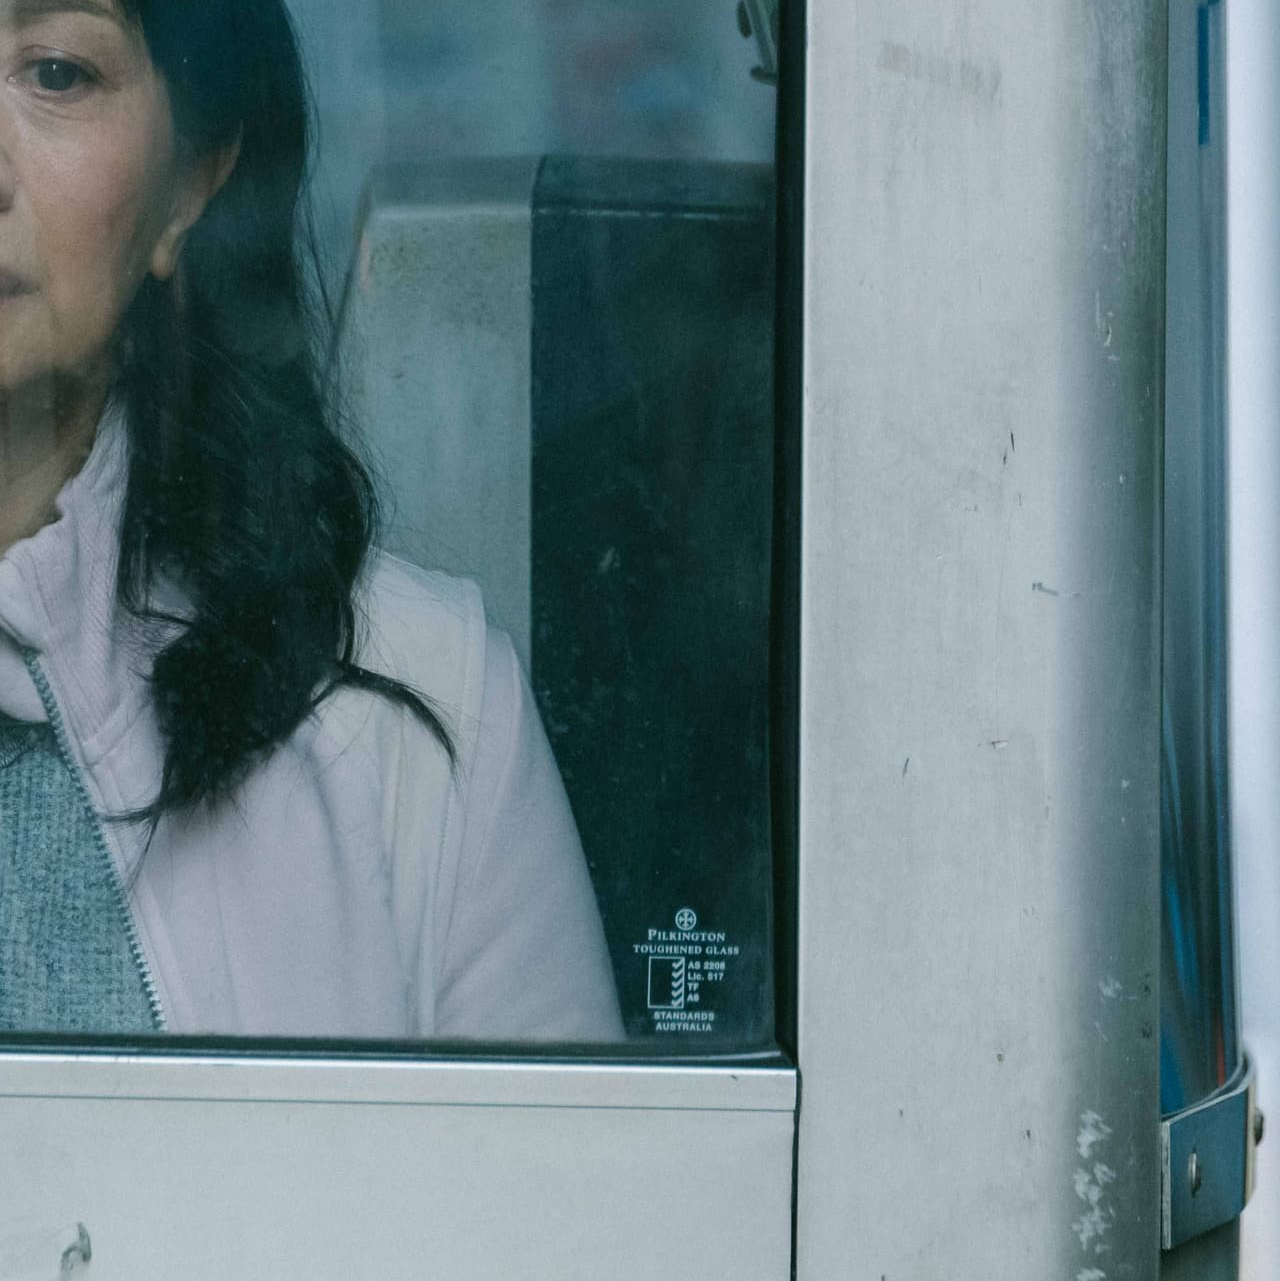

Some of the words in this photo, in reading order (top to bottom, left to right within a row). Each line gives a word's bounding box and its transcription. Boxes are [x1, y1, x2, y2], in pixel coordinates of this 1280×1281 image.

[647, 928, 726, 942] PILKINGTON
[632, 944, 702, 955] TOUGHENED
[705, 946, 740, 956] GLASS
[653, 1011, 715, 1021] STANDARDS
[655, 1022, 713, 1032] AUSTRALIA
